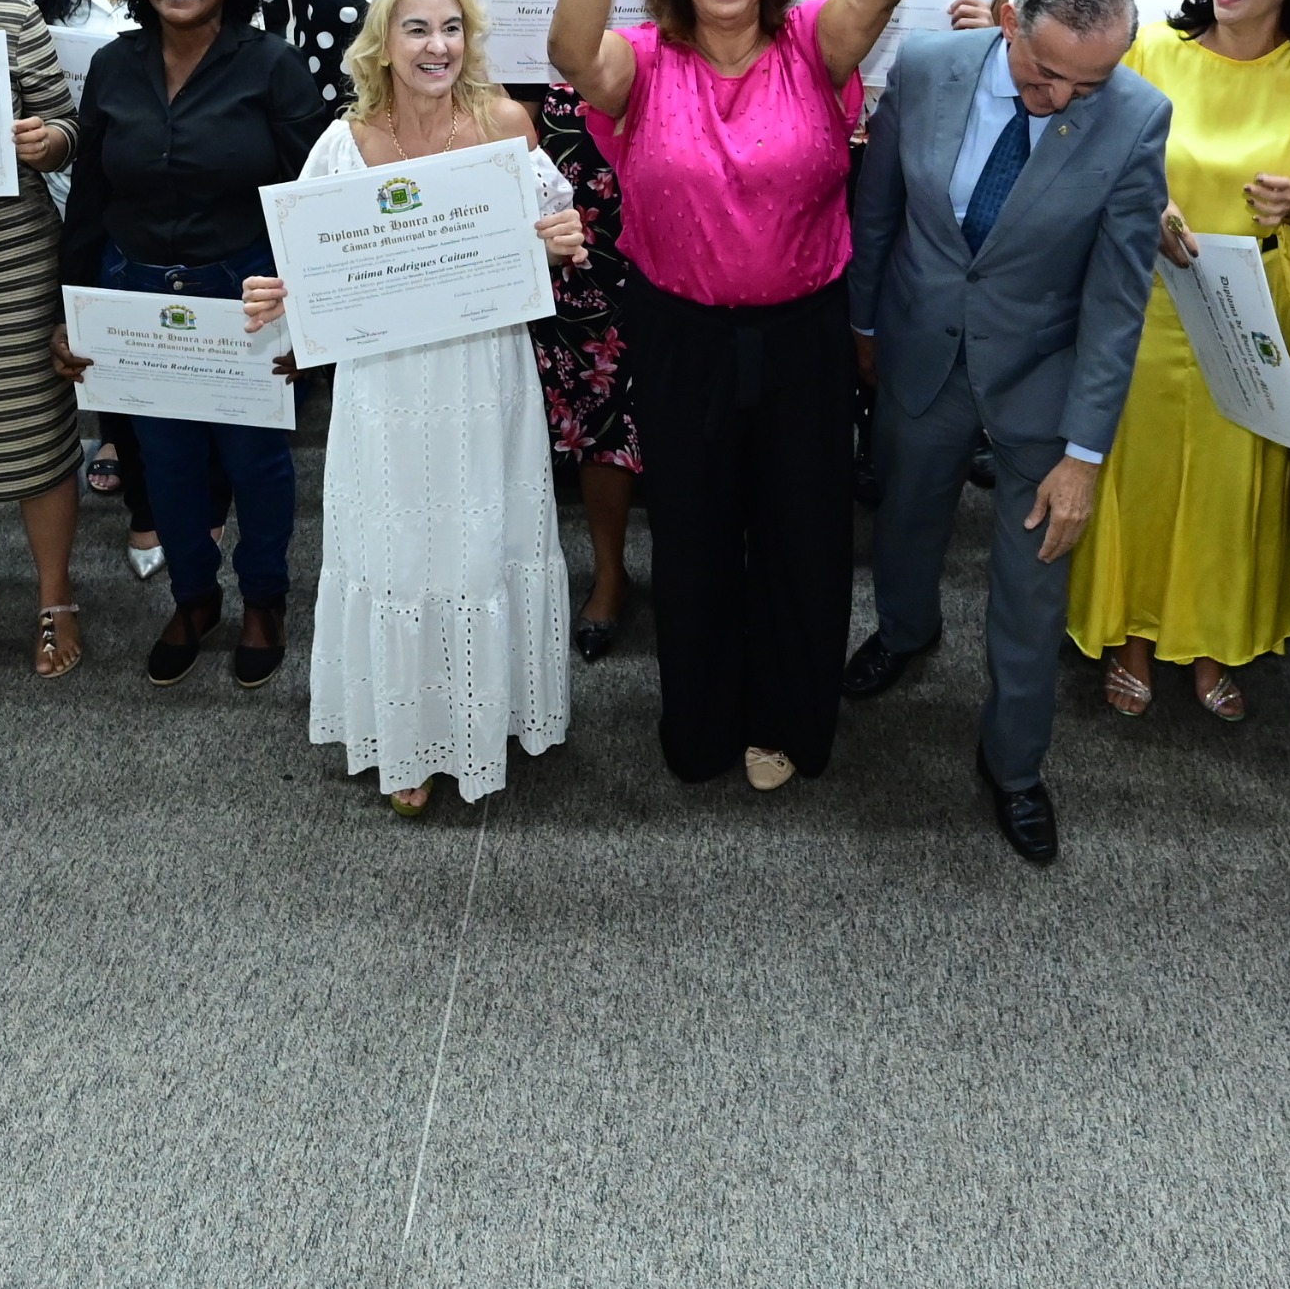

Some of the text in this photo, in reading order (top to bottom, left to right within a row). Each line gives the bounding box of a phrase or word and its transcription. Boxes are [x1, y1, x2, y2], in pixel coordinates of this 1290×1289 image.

[516, 6, 543, 14] Maria
[317, 204, 490, 244] Diploma de Honra ao Mérito
[341, 221, 476, 253] Câmara Municipal de Goiânia
[347, 250, 479, 283] Fátima Rodrigues Caitano
[107, 327, 150, 339] Diploma
[152, 332, 163, 340] de
[167, 332, 199, 344] Honra
[217, 337, 254, 351] Mérito
[118, 358, 139, 366] Rosa
[142, 360, 168, 369] Maria
[170, 363, 213, 373] Rodrigues
[228, 368, 245, 377] Luz
